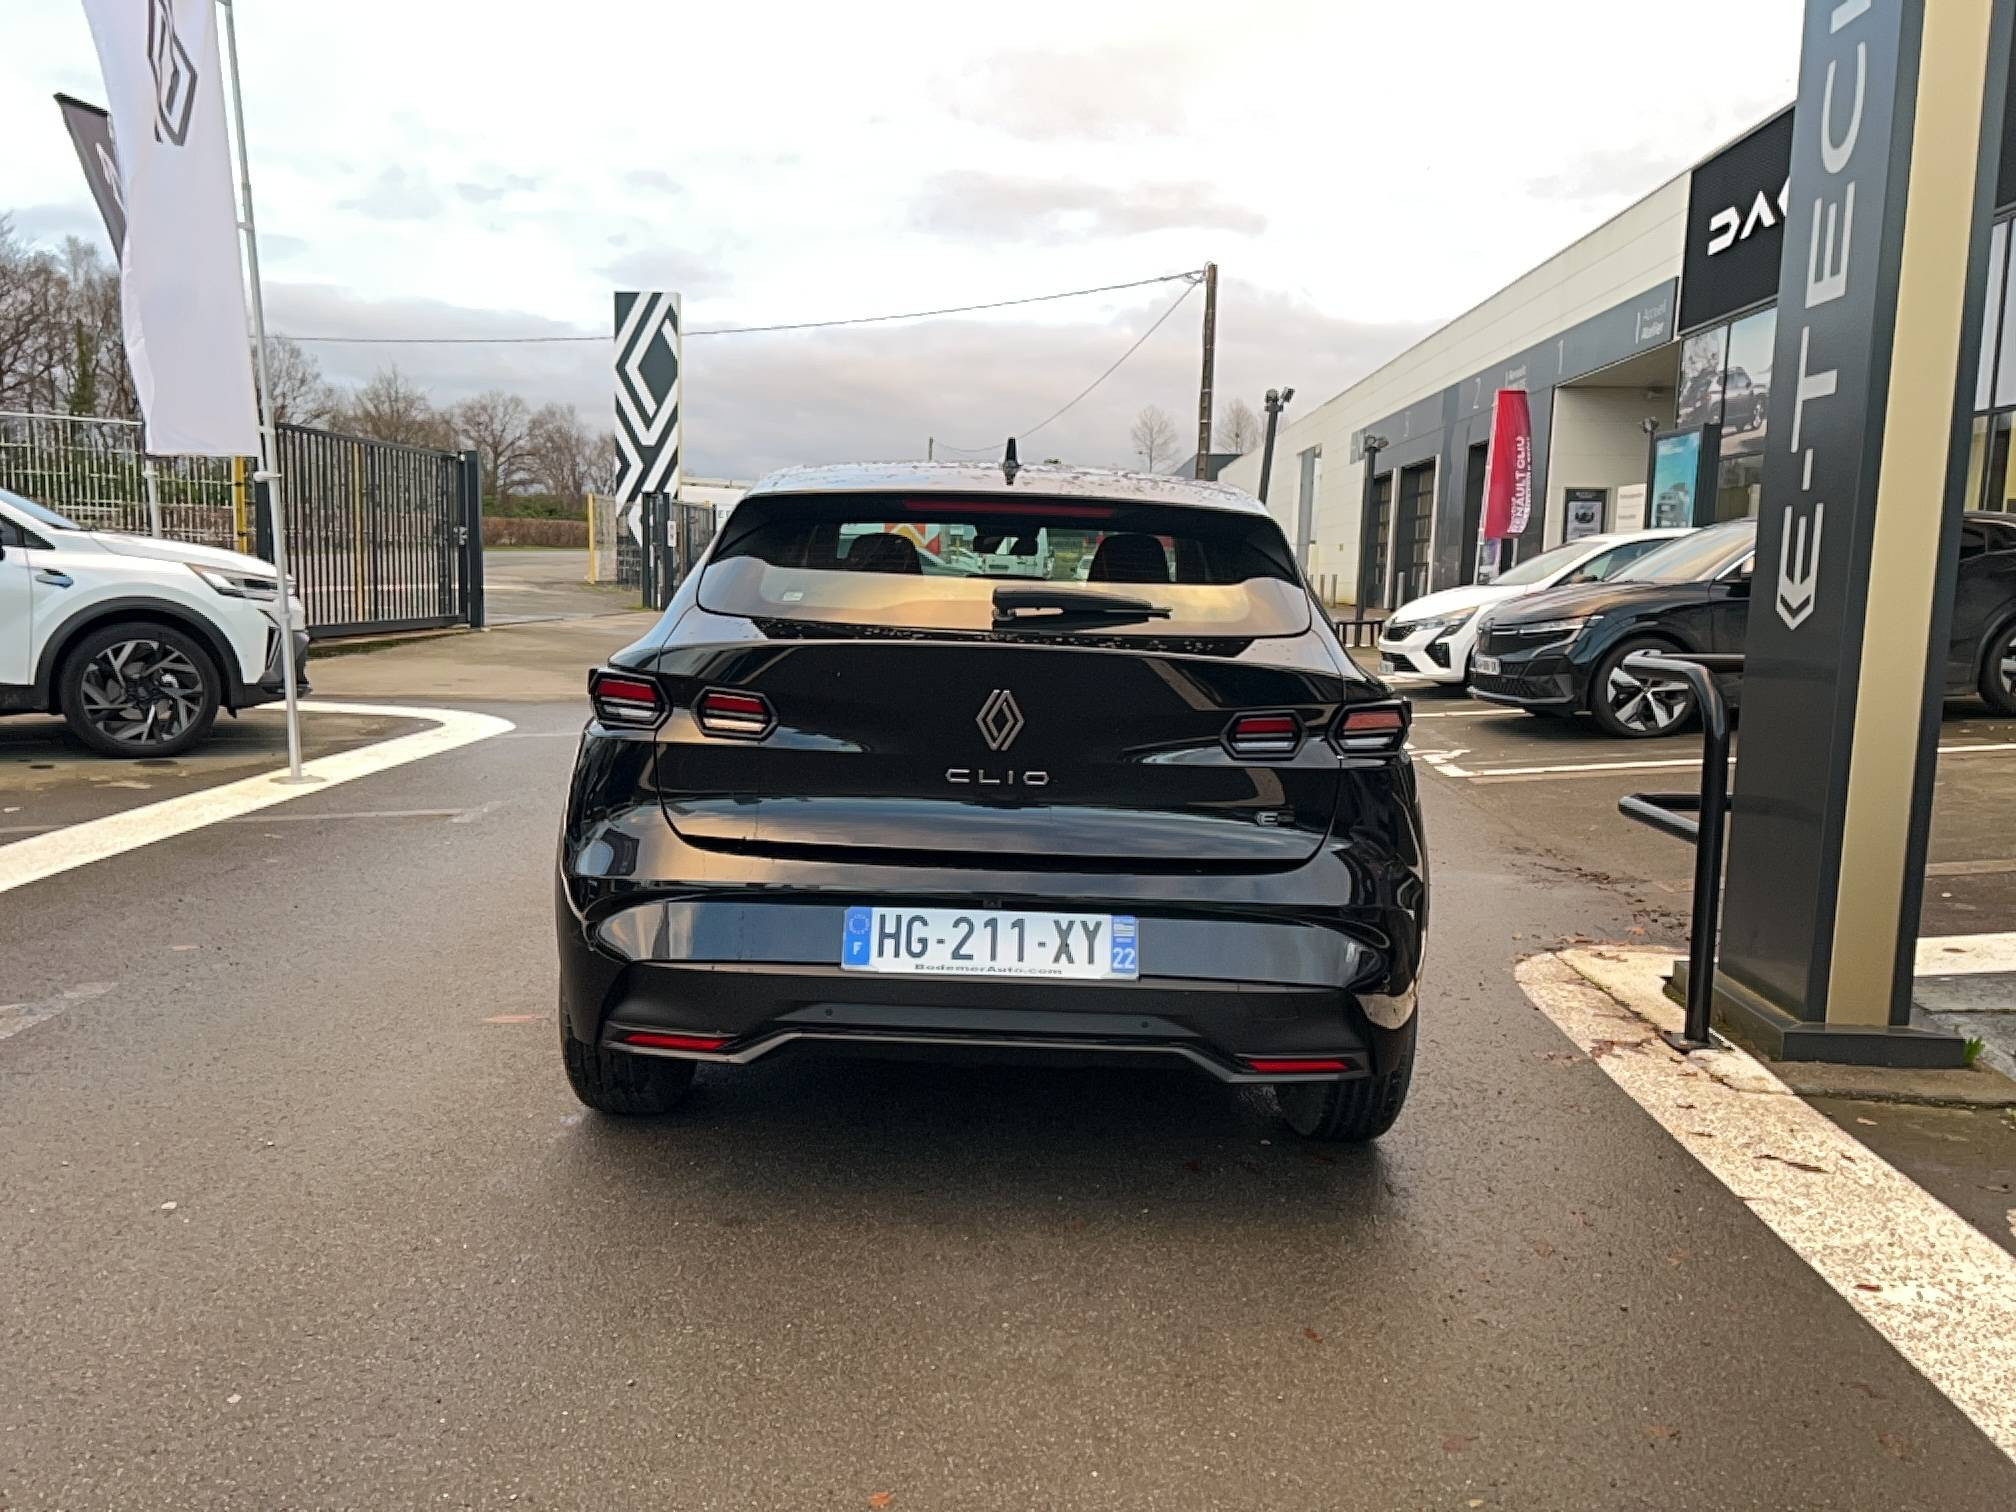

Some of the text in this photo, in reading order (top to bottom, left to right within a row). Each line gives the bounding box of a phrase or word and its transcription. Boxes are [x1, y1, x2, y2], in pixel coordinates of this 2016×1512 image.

[1775, 0, 1872, 631] E-TEC
[1472, 377, 1481, 409] 2
[945, 768, 1050, 785] CLIO
[852, 942, 863, 955] F
[877, 913, 1102, 965] HG-211-XY
[1113, 947, 1136, 969] 22
